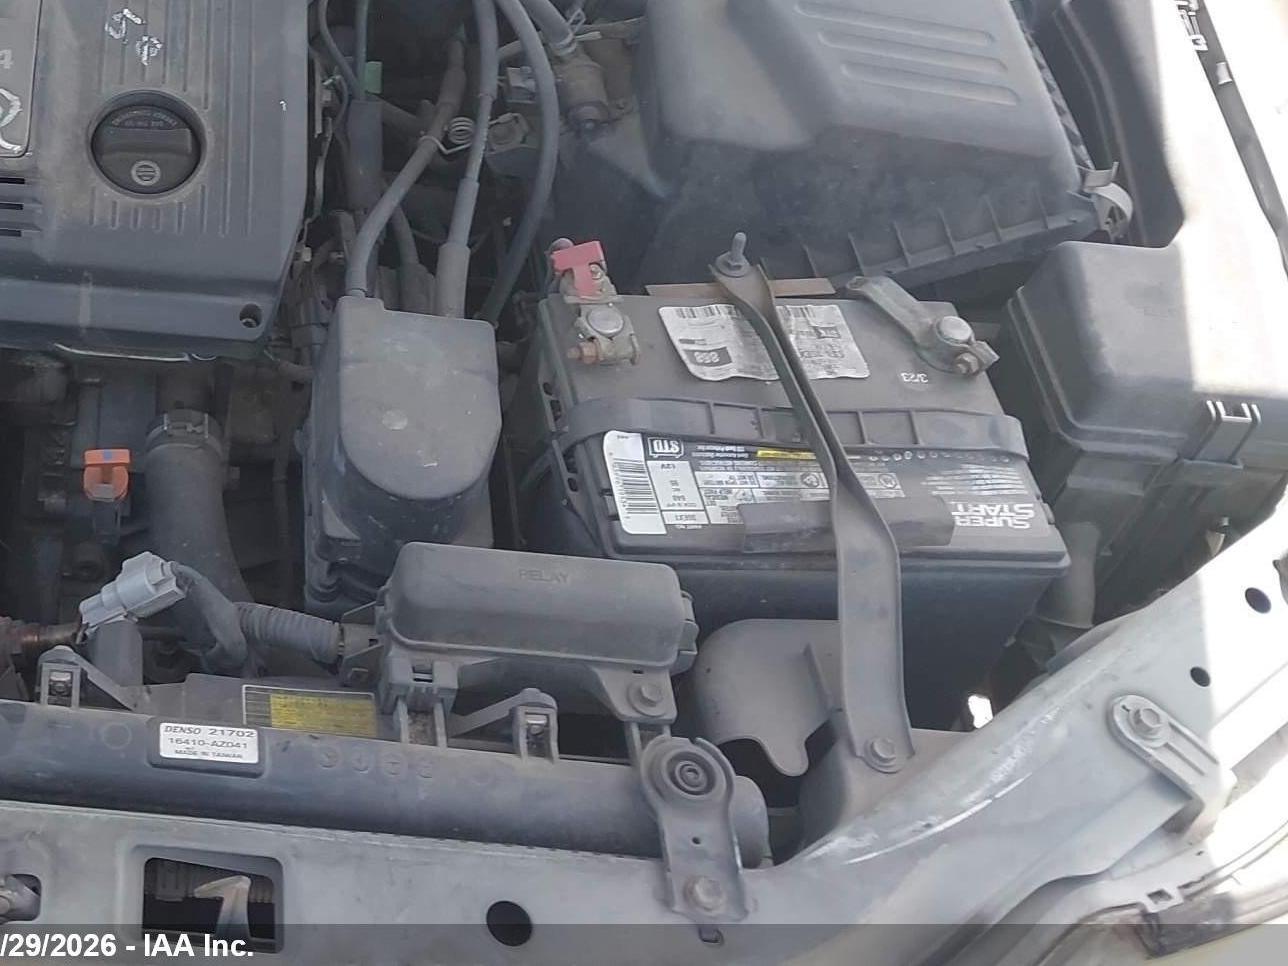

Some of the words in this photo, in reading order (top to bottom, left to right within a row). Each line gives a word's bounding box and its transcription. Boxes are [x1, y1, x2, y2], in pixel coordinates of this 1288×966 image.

[653, 439, 680, 454] STD
[951, 502, 1036, 518] START
[954, 515, 1031, 530] SUPER
[518, 568, 570, 585] RELAY
[163, 725, 202, 735] DENSO
[208, 728, 256, 738] 21702
